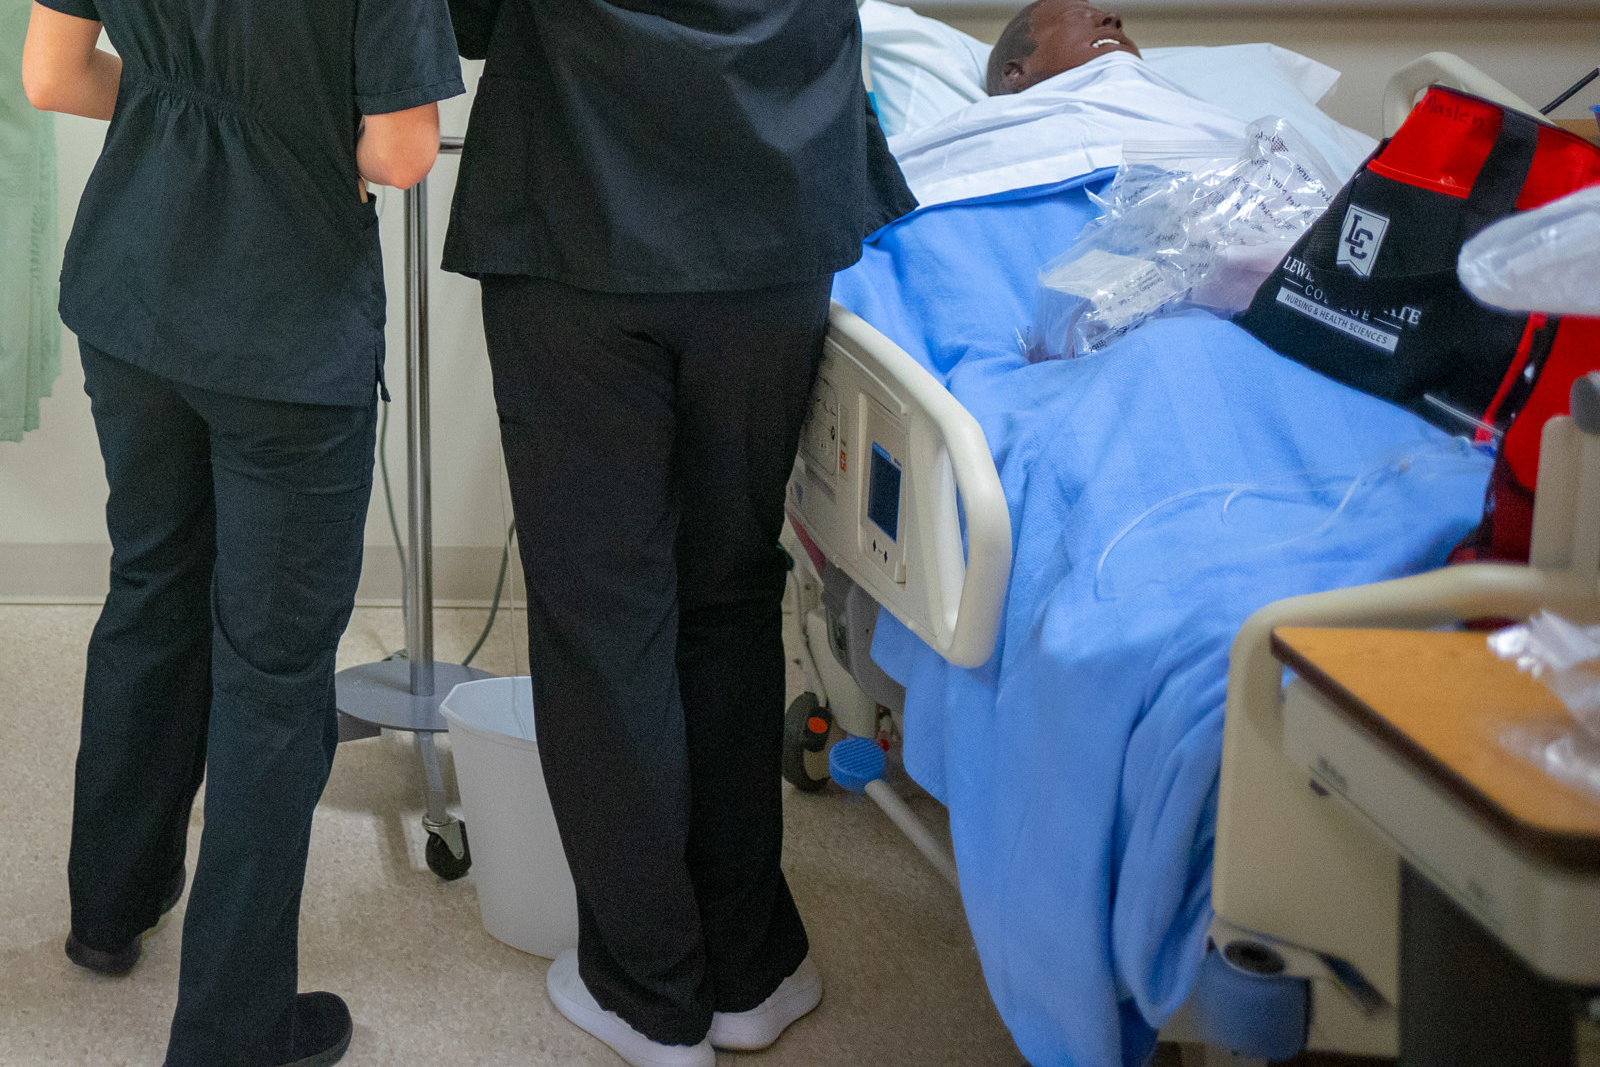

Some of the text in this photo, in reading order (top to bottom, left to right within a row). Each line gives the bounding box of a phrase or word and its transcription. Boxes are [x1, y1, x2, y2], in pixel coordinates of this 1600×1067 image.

[1344, 214, 1374, 260] LC
[1285, 293, 1314, 314] NURSING
[1313, 307, 1319, 316] &
[1319, 310, 1349, 328] HEALTH
[1349, 322, 1388, 345] SCIENCES
